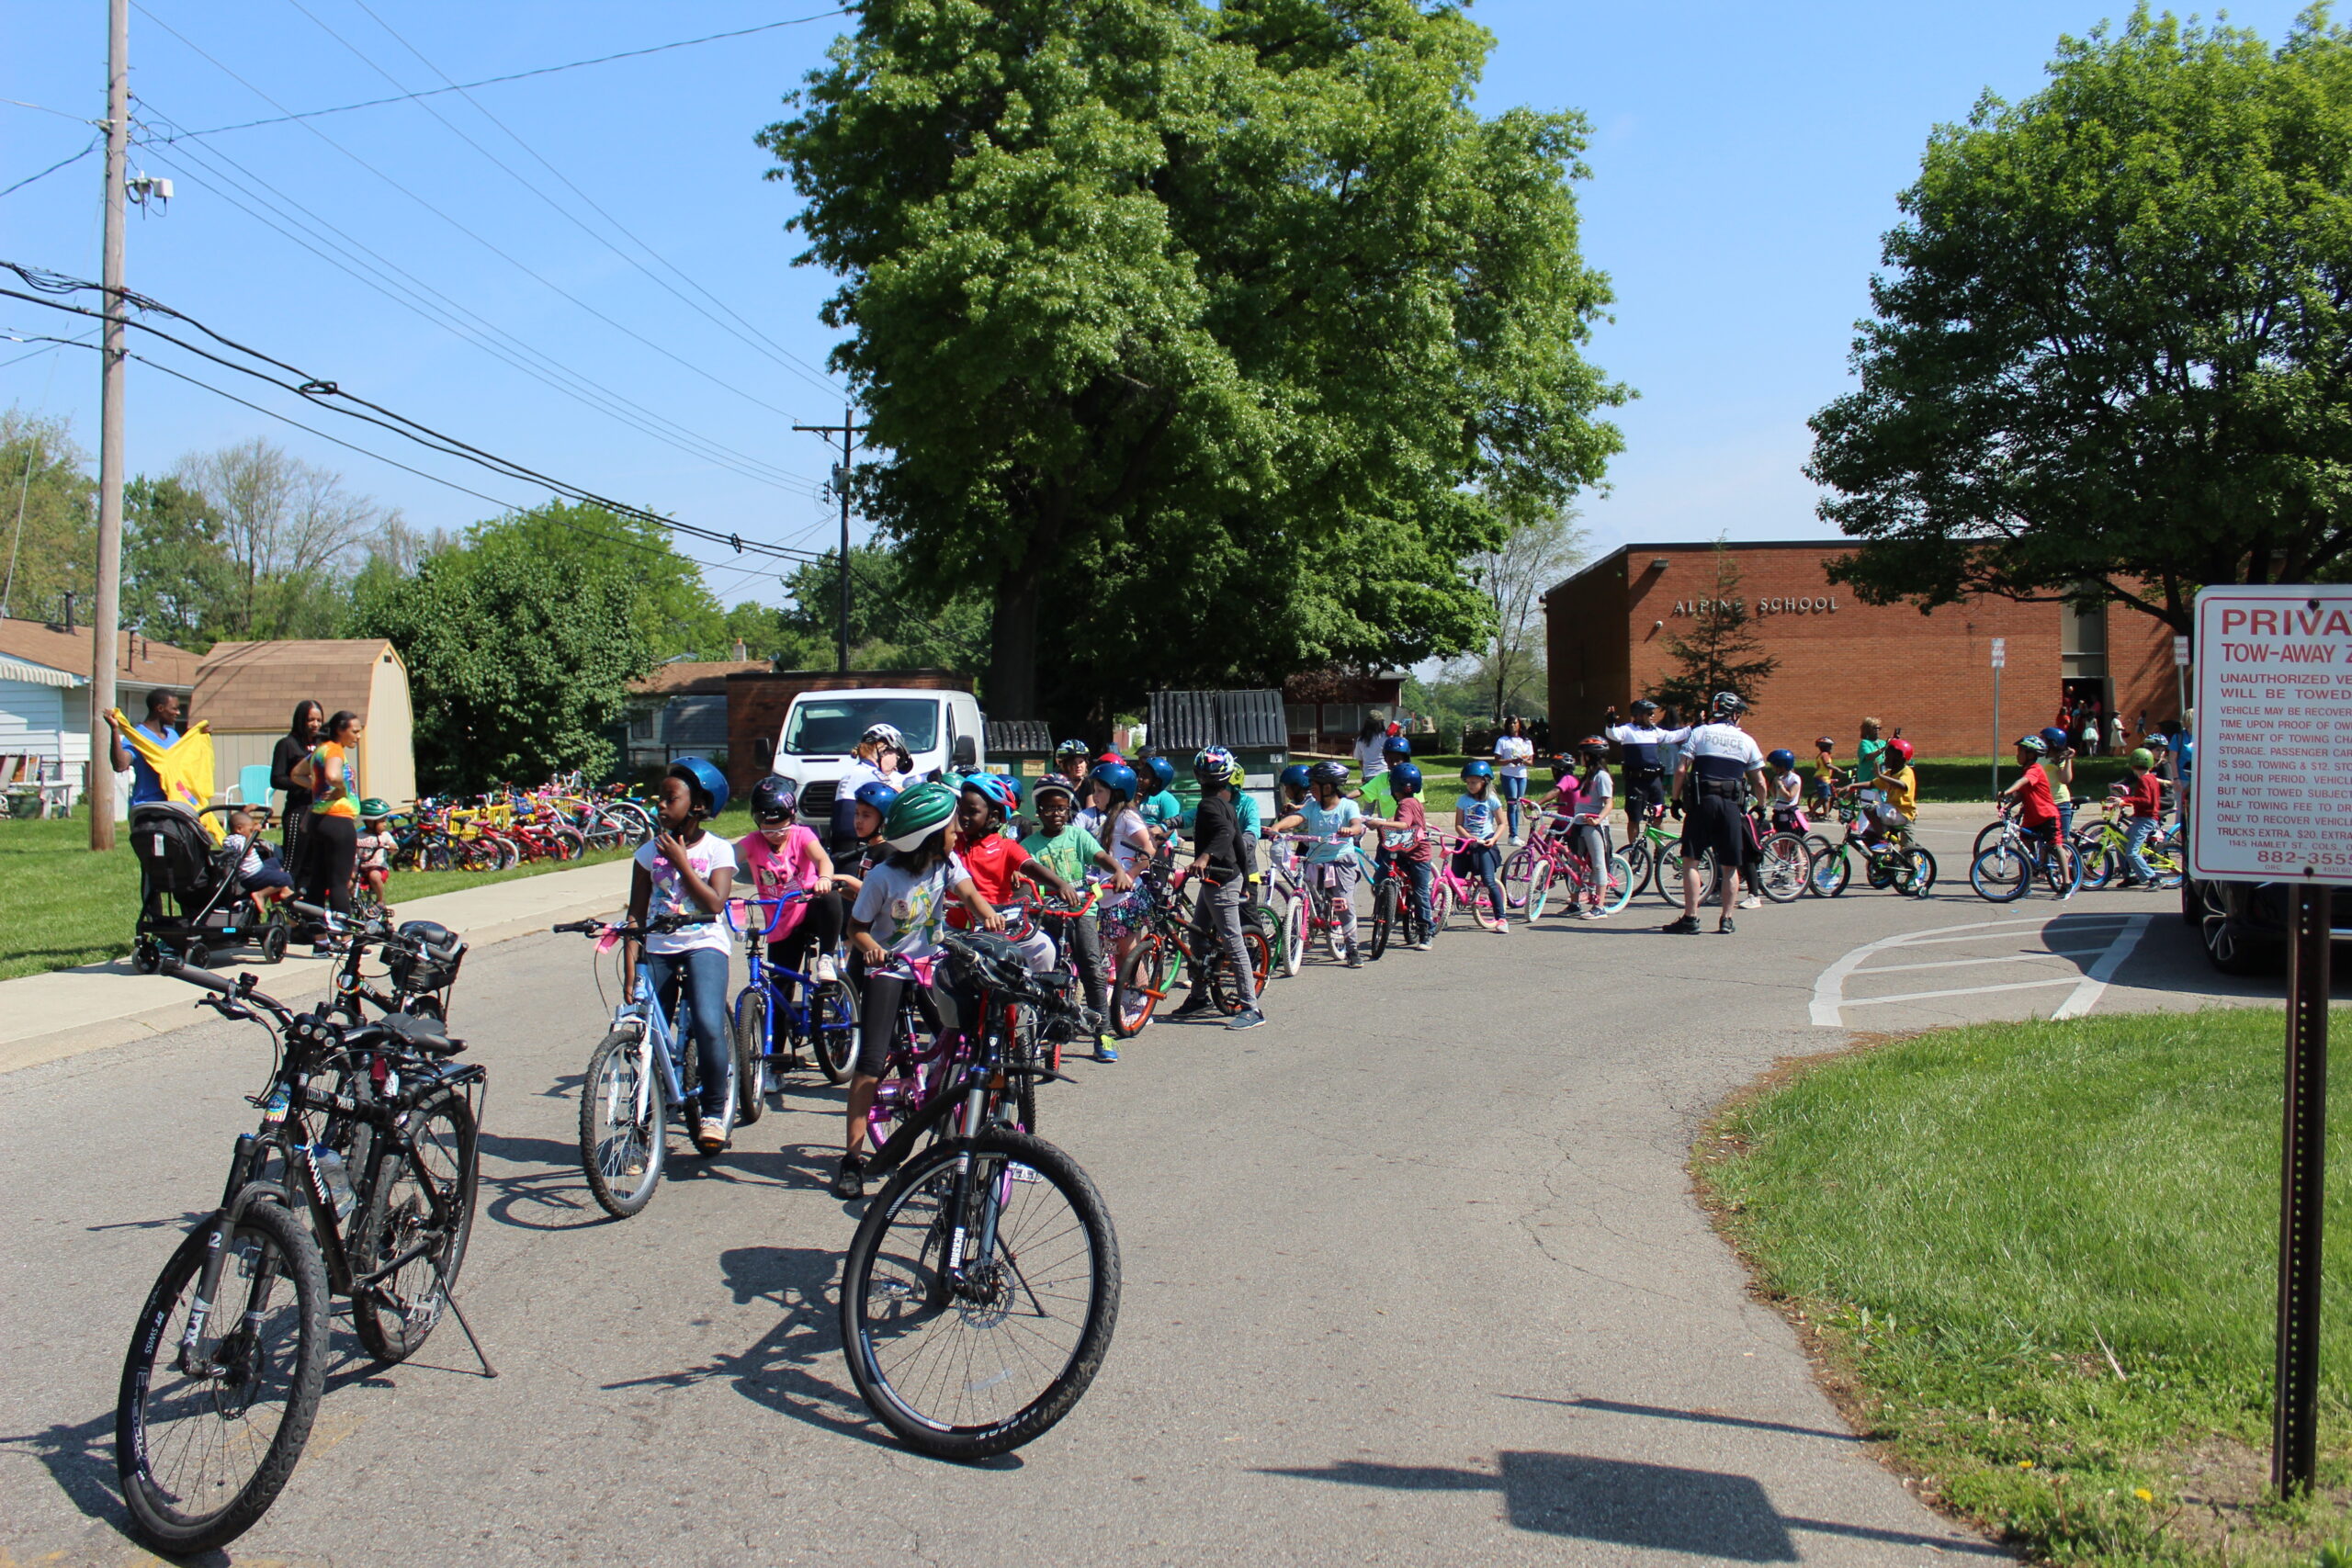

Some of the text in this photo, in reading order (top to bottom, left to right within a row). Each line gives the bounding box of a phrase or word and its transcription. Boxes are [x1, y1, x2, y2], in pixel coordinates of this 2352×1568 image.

[1674, 596, 1838, 613] ALPINE SCHOOL
[2222, 609, 2352, 636] PRIVA
[2221, 643, 2336, 663] TOW-AWAY
[2221, 673, 2330, 684] UNAUTHORIZED
[2221, 688, 2351, 700] WILL BE TOWED
[2221, 705, 2260, 715] VEHICLE
[2265, 706, 2284, 716] MAY
[2288, 707, 2301, 716] BE
[2220, 719, 2243, 728] TIME
[2246, 720, 2274, 728] UPON
[2278, 720, 2312, 729] PROOF
[2316, 721, 2330, 729] OF
[1704, 735, 1743, 750] POLICE
[2219, 733, 2264, 742] PAYMENT
[2269, 733, 2284, 742] OF
[2289, 734, 2329, 743] TOWING
[2219, 746, 2266, 755] STORAGE.
[2270, 747, 2328, 757] PASSENGER
[2218, 760, 2228, 768] IS
[2257, 761, 2296, 770] TOWING
[2300, 761, 2306, 770] &
[2218, 773, 2230, 782] 24
[2235, 773, 2264, 782] HOUR
[2313, 776, 2352, 784] VEHICL
[2217, 787, 2237, 795] BUT
[2242, 787, 2262, 796] NOT
[2267, 788, 2302, 797] TOWED
[2217, 800, 2242, 808] HALF
[2247, 801, 2288, 810] TOWING
[2293, 802, 2312, 811] FEE
[2318, 803, 2332, 812] TO
[2217, 814, 2352, 826] ONLY TO RECOVER VEHICL
[2216, 827, 2256, 837] TRUCKS
[2258, 829, 2292, 838] EXTRA.
[2251, 840, 2286, 849] HAMLET
[949, 1227, 965, 1268] ROCKSHOX
[155, 1311, 165, 1328] DT
[183, 1310, 205, 1347] FOX
[145, 1328, 161, 1355] SWISS
